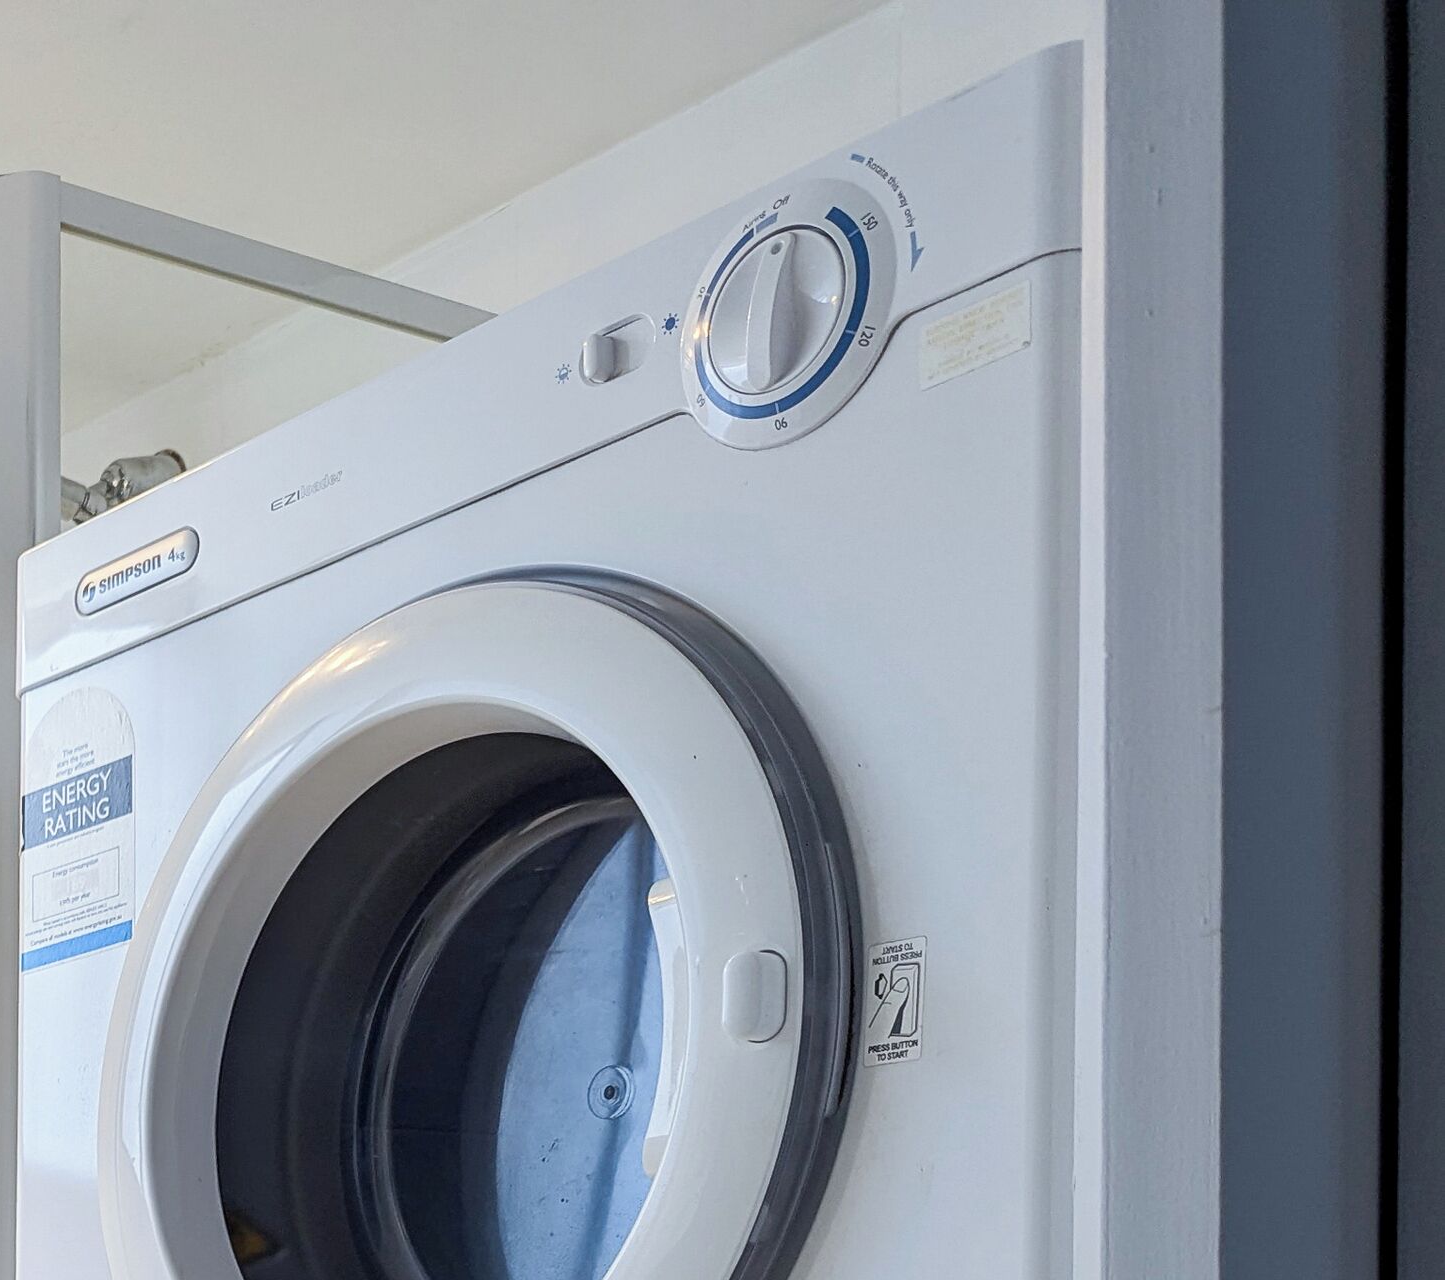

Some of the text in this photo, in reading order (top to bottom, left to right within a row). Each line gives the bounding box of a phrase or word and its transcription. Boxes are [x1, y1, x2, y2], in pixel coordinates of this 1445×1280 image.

[866, 157, 915, 228] Rotate this way only
[773, 194, 790, 210] Off
[860, 212, 878, 231] 150
[858, 325, 876, 347] 120
[774, 418, 788, 431] 90
[98, 547, 186, 594] SIMPSON 4kg
[42, 768, 112, 814] ENERGY
[44, 798, 110, 840] RATING
[882, 943, 913, 955] TO START
[872, 950, 923, 966] PRESS BUTTON
[868, 1040, 919, 1054] PRESS BUTTON
[877, 1050, 909, 1062] TO START
